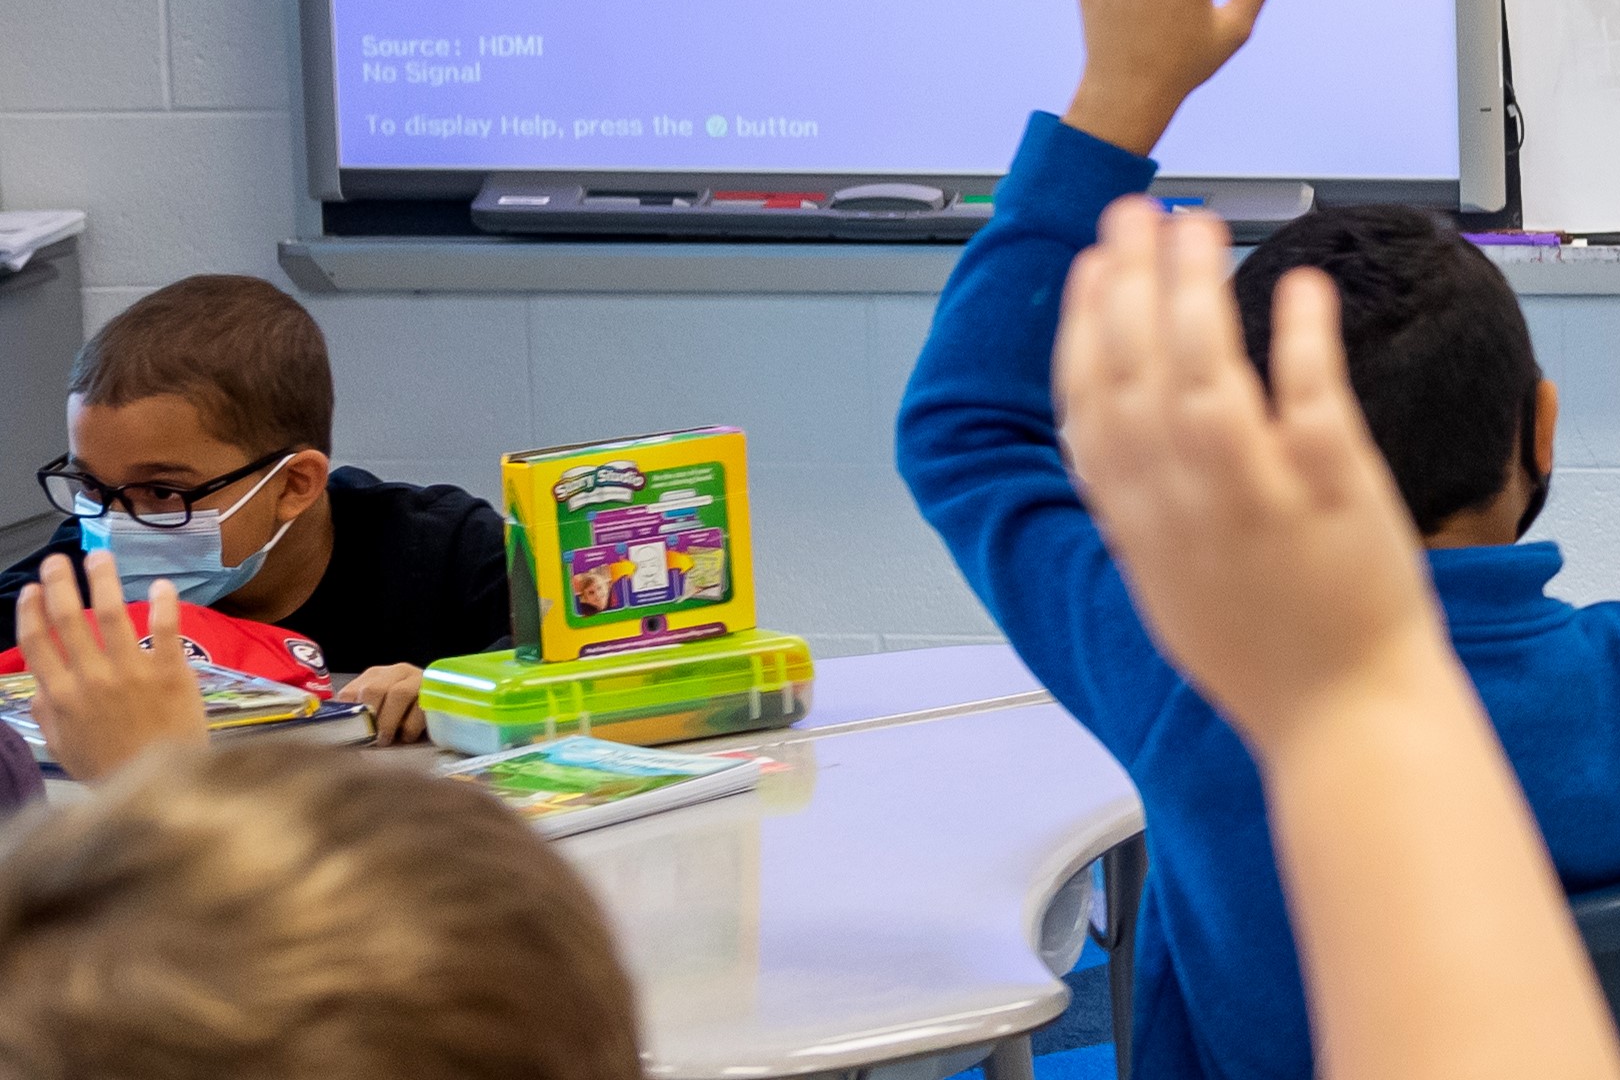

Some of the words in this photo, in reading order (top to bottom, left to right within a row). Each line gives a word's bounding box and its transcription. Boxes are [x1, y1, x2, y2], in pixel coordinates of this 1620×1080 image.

[362, 35, 462, 59] Source:
[478, 35, 545, 57] HDMI
[362, 62, 398, 84] No
[404, 61, 482, 88] Signal
[366, 114, 397, 137] To
[404, 114, 492, 141] display
[500, 115, 566, 140] Help,
[573, 118, 644, 140] press
[652, 115, 694, 137] the
[736, 115, 819, 138] button
